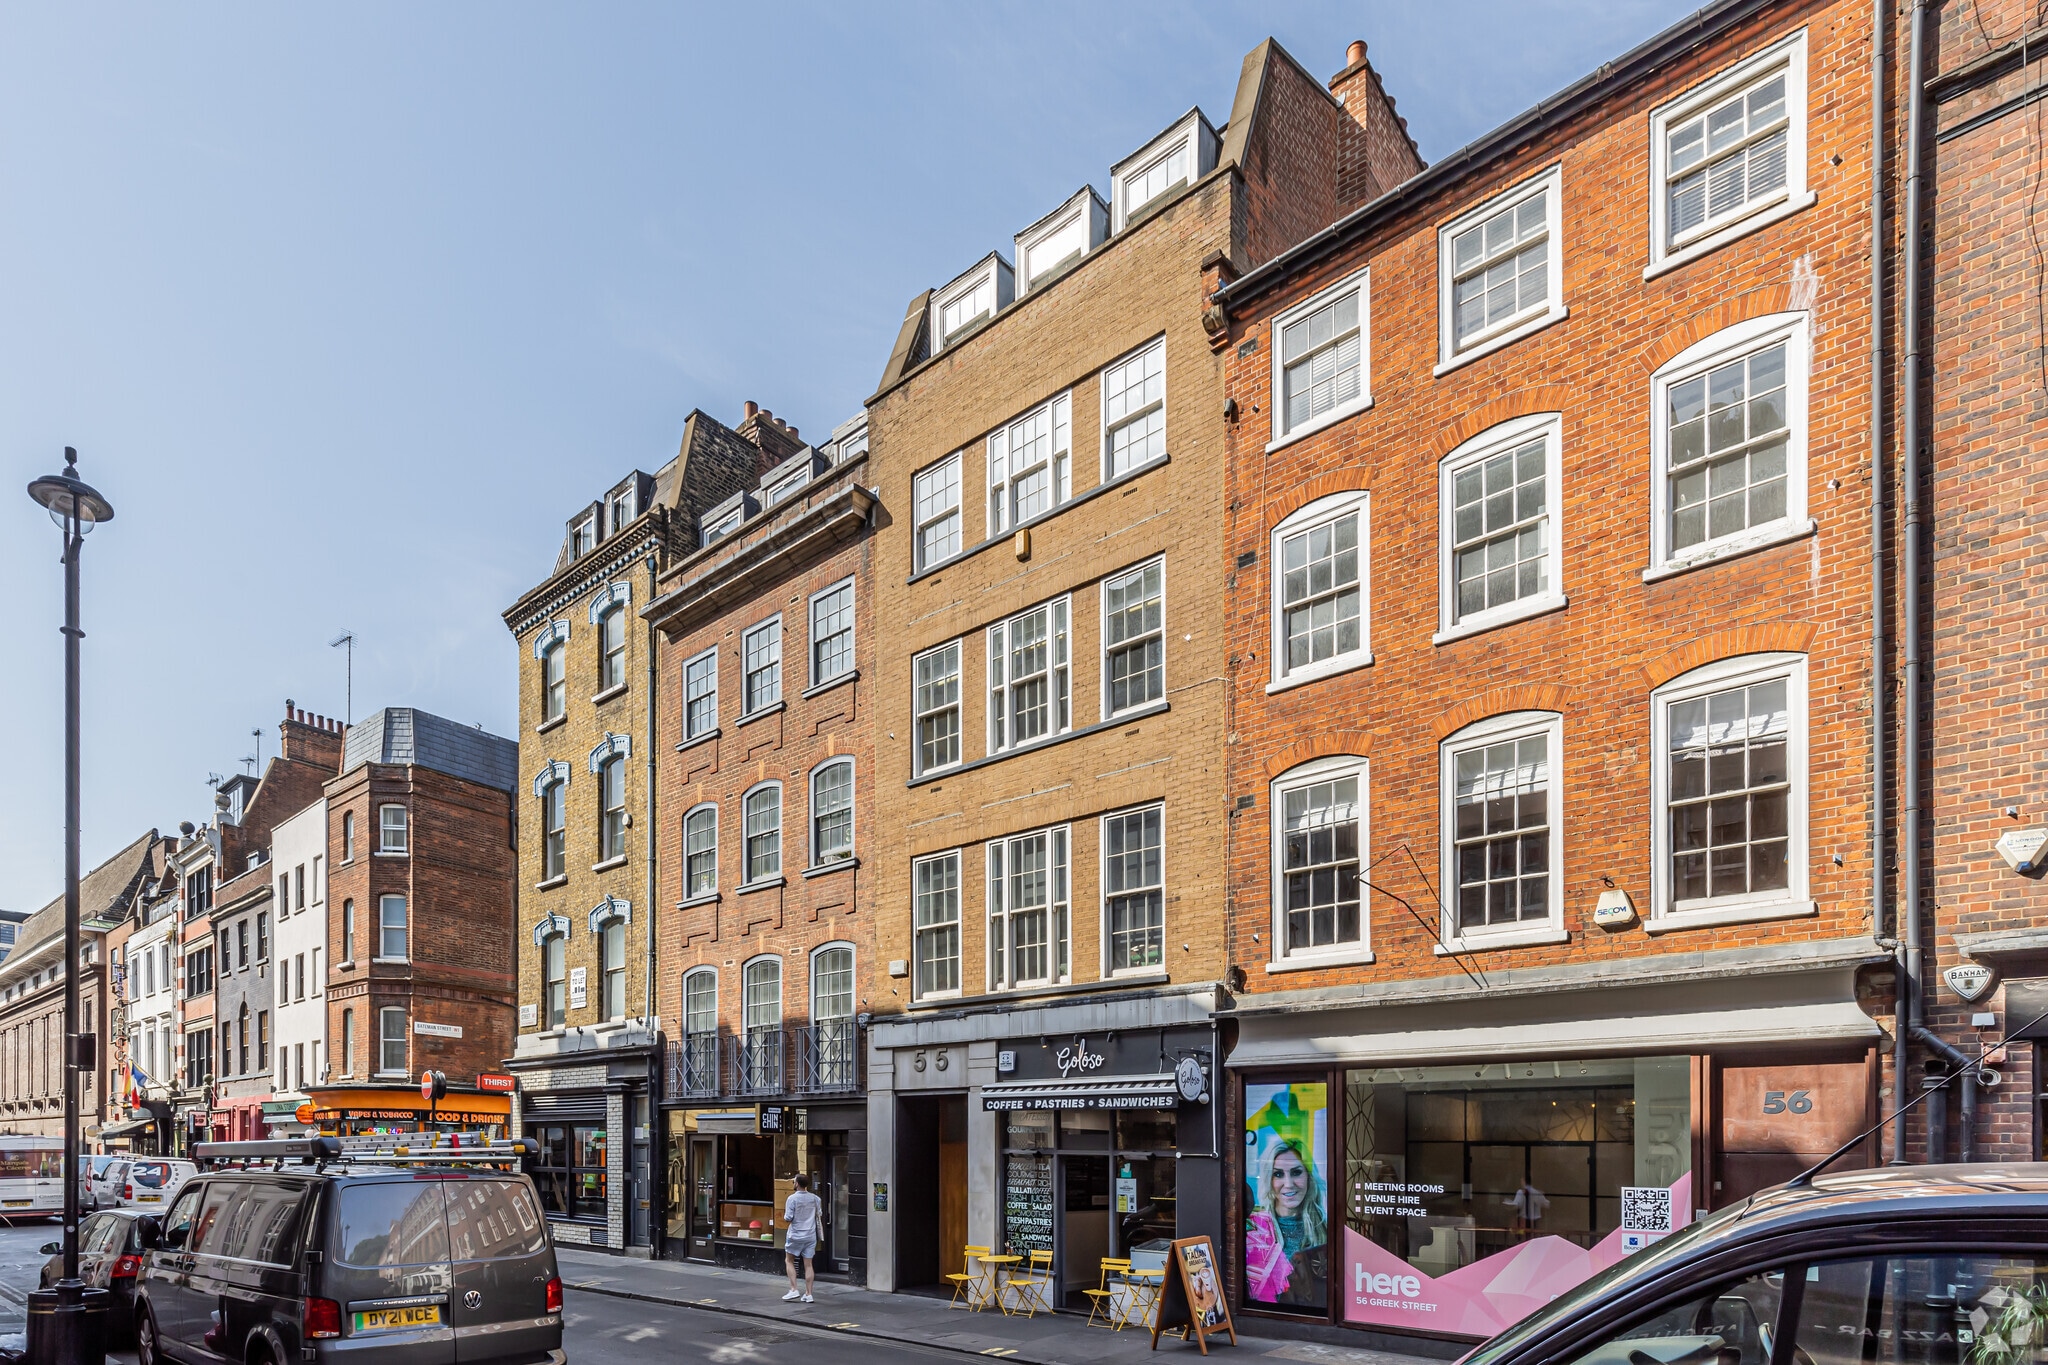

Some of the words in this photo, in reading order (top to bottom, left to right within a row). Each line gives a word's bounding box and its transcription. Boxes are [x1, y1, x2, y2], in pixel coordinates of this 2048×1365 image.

[1597, 905, 1627, 916] SECOM
[1951, 969, 1988, 980] BANHAM
[484, 1078, 513, 1087] THIRST
[986, 1101, 1024, 1110] COFFEE
[1034, 1098, 1085, 1109] PASTRIES
[1098, 1096, 1173, 1108] SANDWICHES
[1763, 1089, 1812, 1115] 56
[348, 1110, 371, 1118] VAPES
[372, 1110, 378, 1118] &
[379, 1111, 414, 1119] TOBACCO
[462, 1114, 470, 1123] &
[471, 1114, 505, 1124] DRINKS
[762, 1113, 779, 1121] CHIN
[762, 1119, 779, 1129] CHIN
[133, 1166, 161, 1176] 24
[1007, 1178, 1037, 1186] BREAKFAST
[1007, 1186, 1031, 1194] FRULLATI
[1364, 1182, 1406, 1192] MEETING
[1407, 1184, 1445, 1193] ROOMS
[1030, 1194, 1053, 1204] JUICES
[1364, 1194, 1396, 1204] VENUE
[1397, 1196, 1420, 1205] HIRE
[1364, 1206, 1395, 1216] EVENT
[1396, 1208, 1427, 1217] SPACE
[1007, 1216, 1025, 1224] FRESH
[1025, 1217, 1053, 1226] PASTRIES
[1007, 1224, 1020, 1232] HOT
[1020, 1225, 1052, 1234] CHOCOLATE
[1007, 1231, 1020, 1240] TEA
[1021, 1234, 1053, 1242] SANDWICH
[1187, 1250, 1206, 1260] ITALIAN
[1355, 1262, 1421, 1298] here
[1356, 1296, 1368, 1305] 56
[1369, 1298, 1400, 1309] GREEK
[1402, 1301, 1438, 1313] STREET
[368, 1311, 402, 1326] DY21
[406, 1308, 433, 1322] WCE
